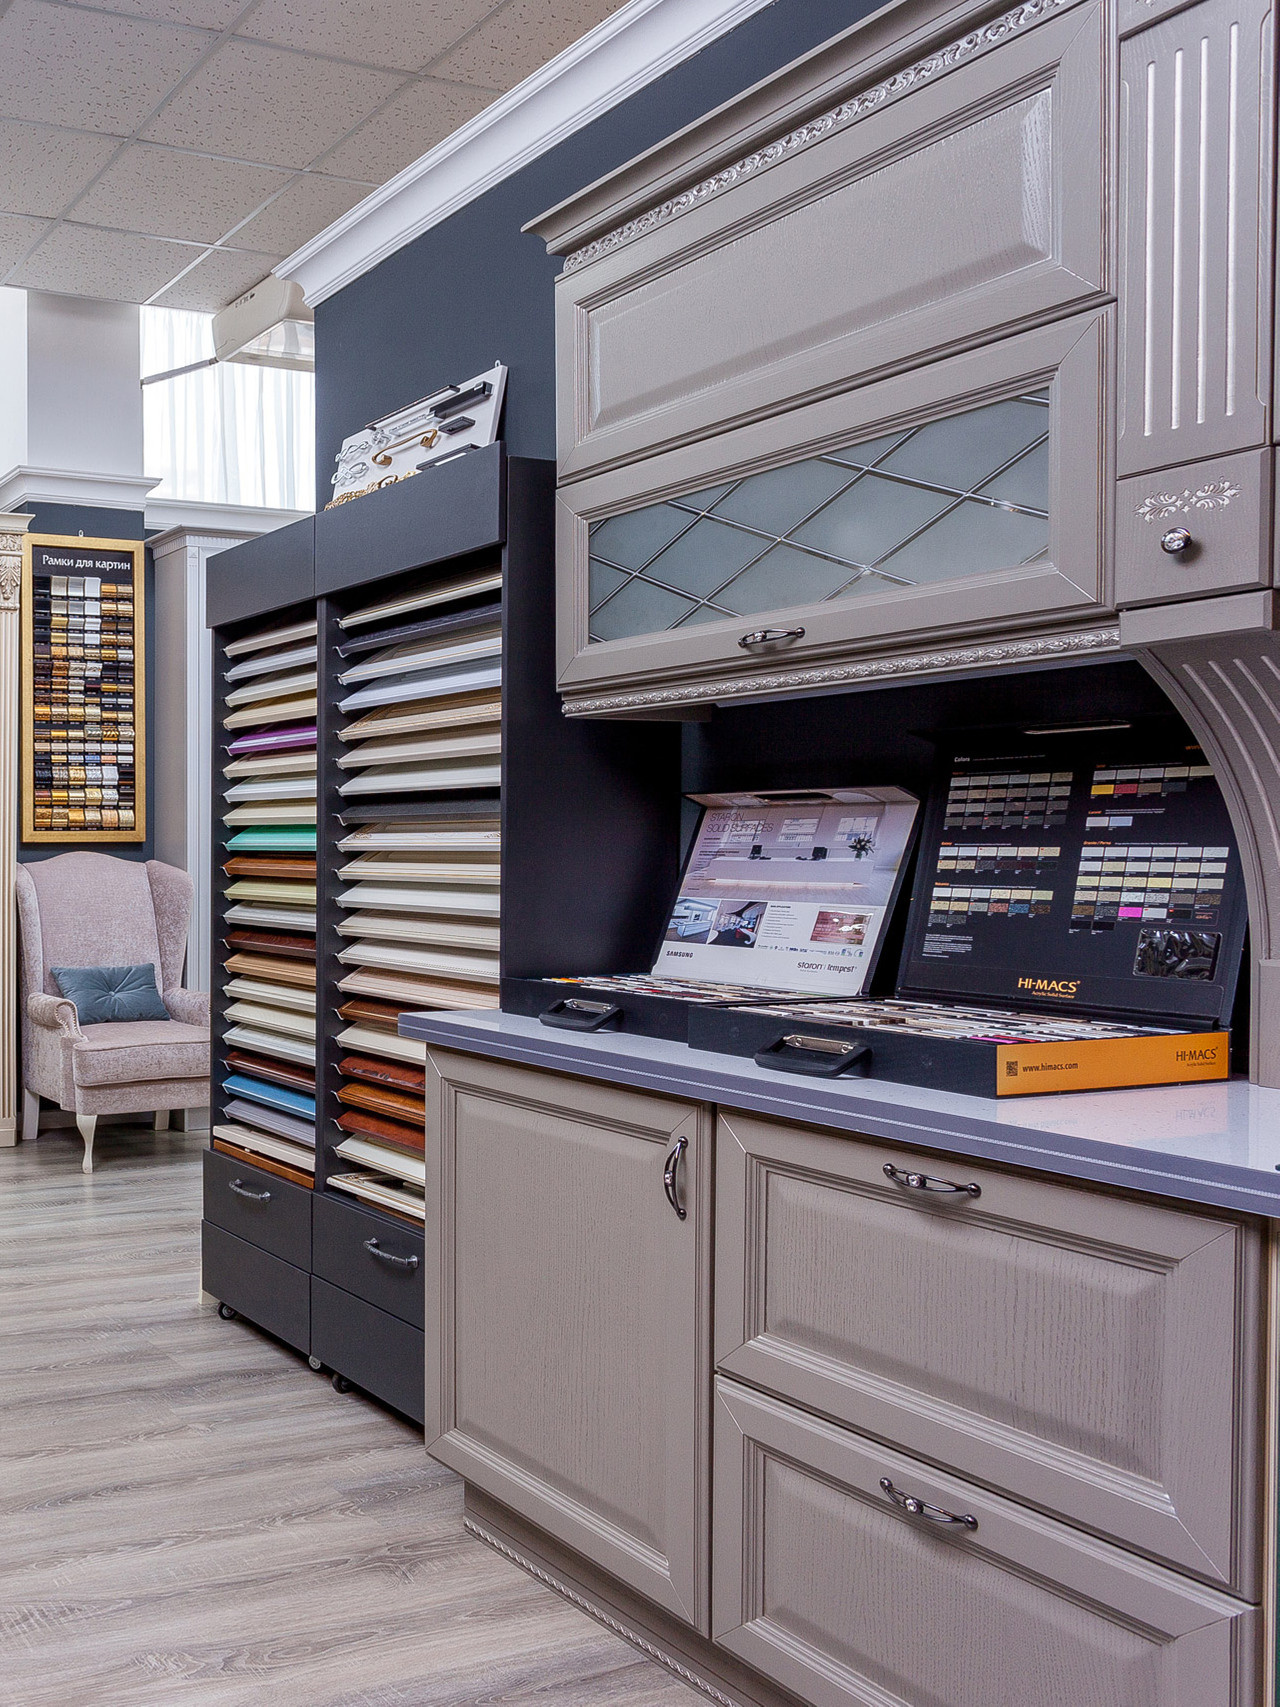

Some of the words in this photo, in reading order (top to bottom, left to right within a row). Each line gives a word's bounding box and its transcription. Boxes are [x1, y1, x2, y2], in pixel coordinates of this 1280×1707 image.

[42, 554, 74, 566] Рамки
[75, 559, 94, 568] для
[95, 560, 131, 571] картин
[710, 812, 745, 822] STARON
[706, 823, 730, 833] SOLID
[730, 822, 774, 833] SURFACES
[666, 950, 694, 958] SAMSUNG
[797, 961, 823, 970] staron
[827, 963, 855, 974] tempest
[1022, 1062, 1079, 1072] www.himacs.com
